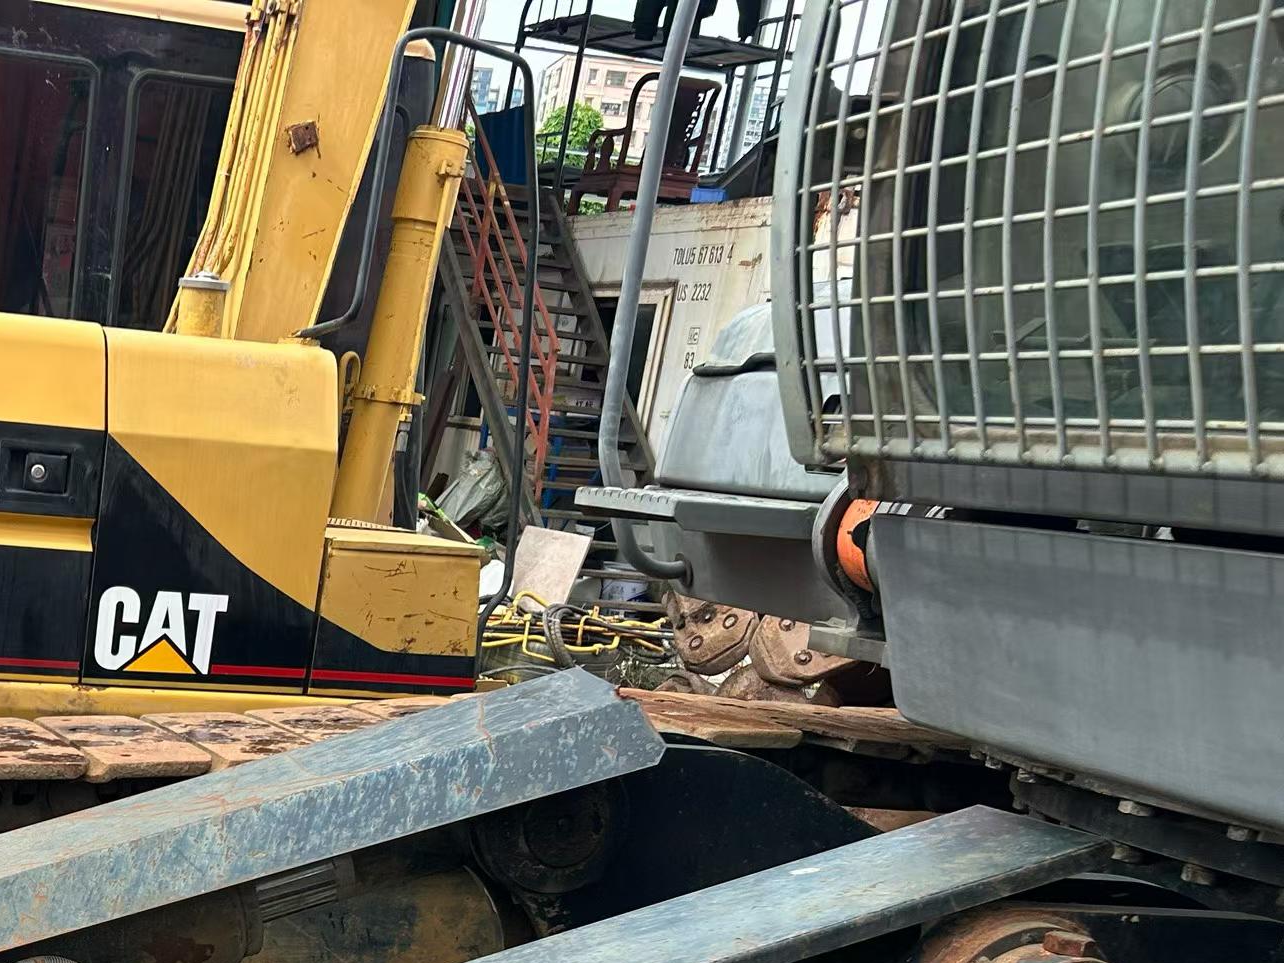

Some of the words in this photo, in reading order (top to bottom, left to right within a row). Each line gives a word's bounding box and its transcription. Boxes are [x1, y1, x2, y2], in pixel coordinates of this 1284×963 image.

[676, 284, 689, 302] US
[691, 283, 712, 301] 2232
[683, 352, 695, 370] 83
[94, 585, 230, 675] CAT
